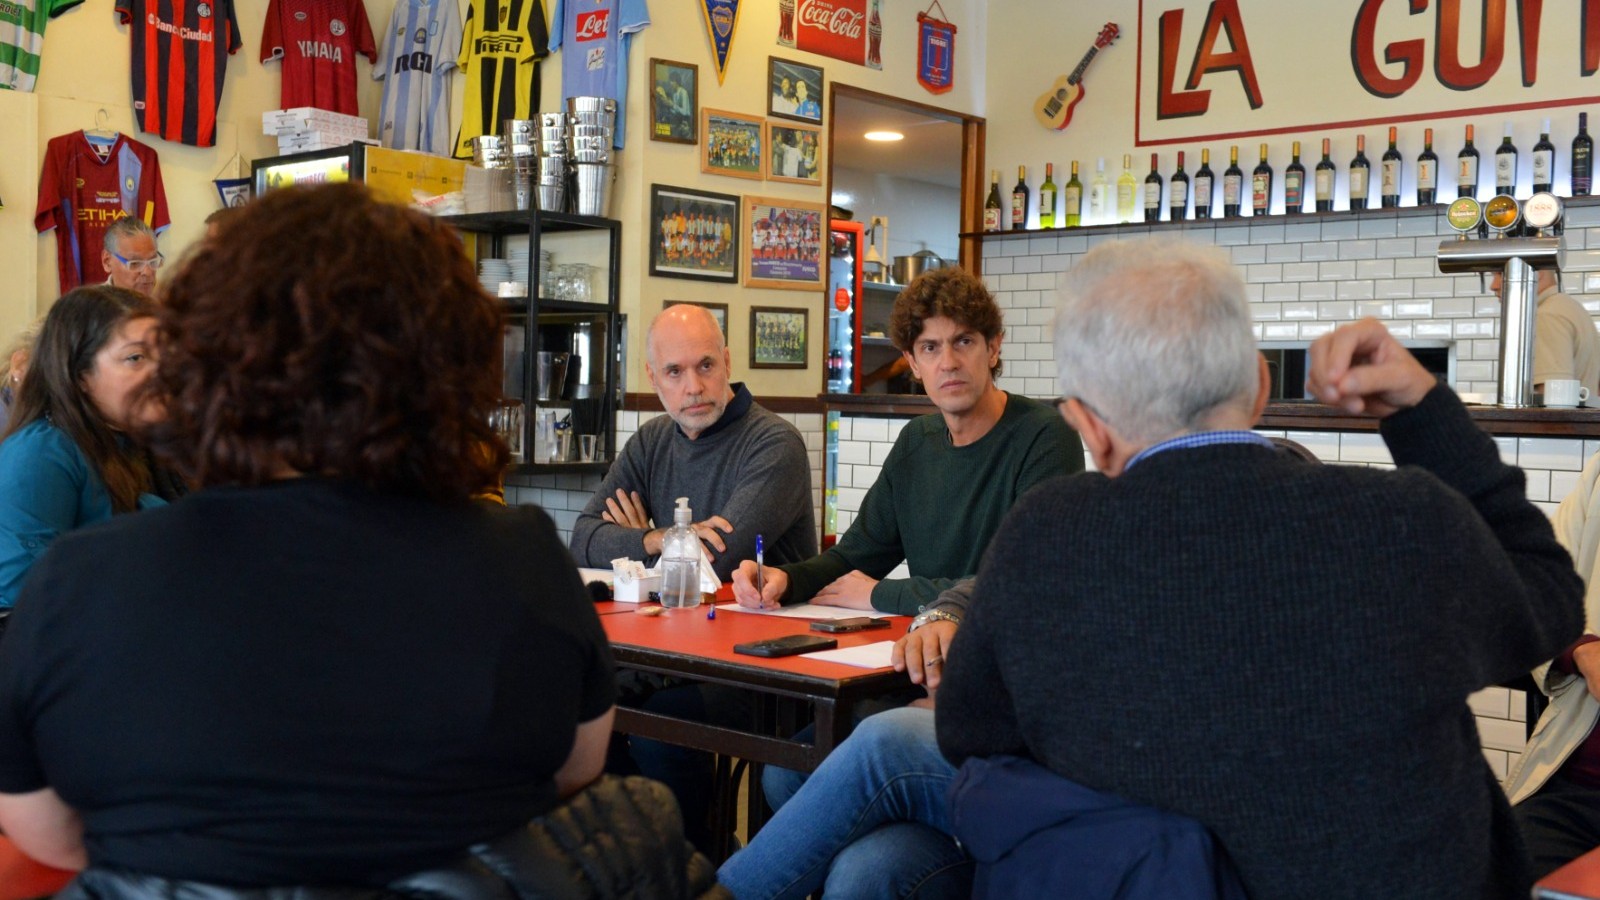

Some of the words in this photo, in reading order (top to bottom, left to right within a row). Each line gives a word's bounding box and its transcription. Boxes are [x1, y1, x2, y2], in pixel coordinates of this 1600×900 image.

[180, 27, 212, 43] Ciudad
[798, 0, 864, 39] Coca-Cola
[1157, 0, 1264, 120] LA
